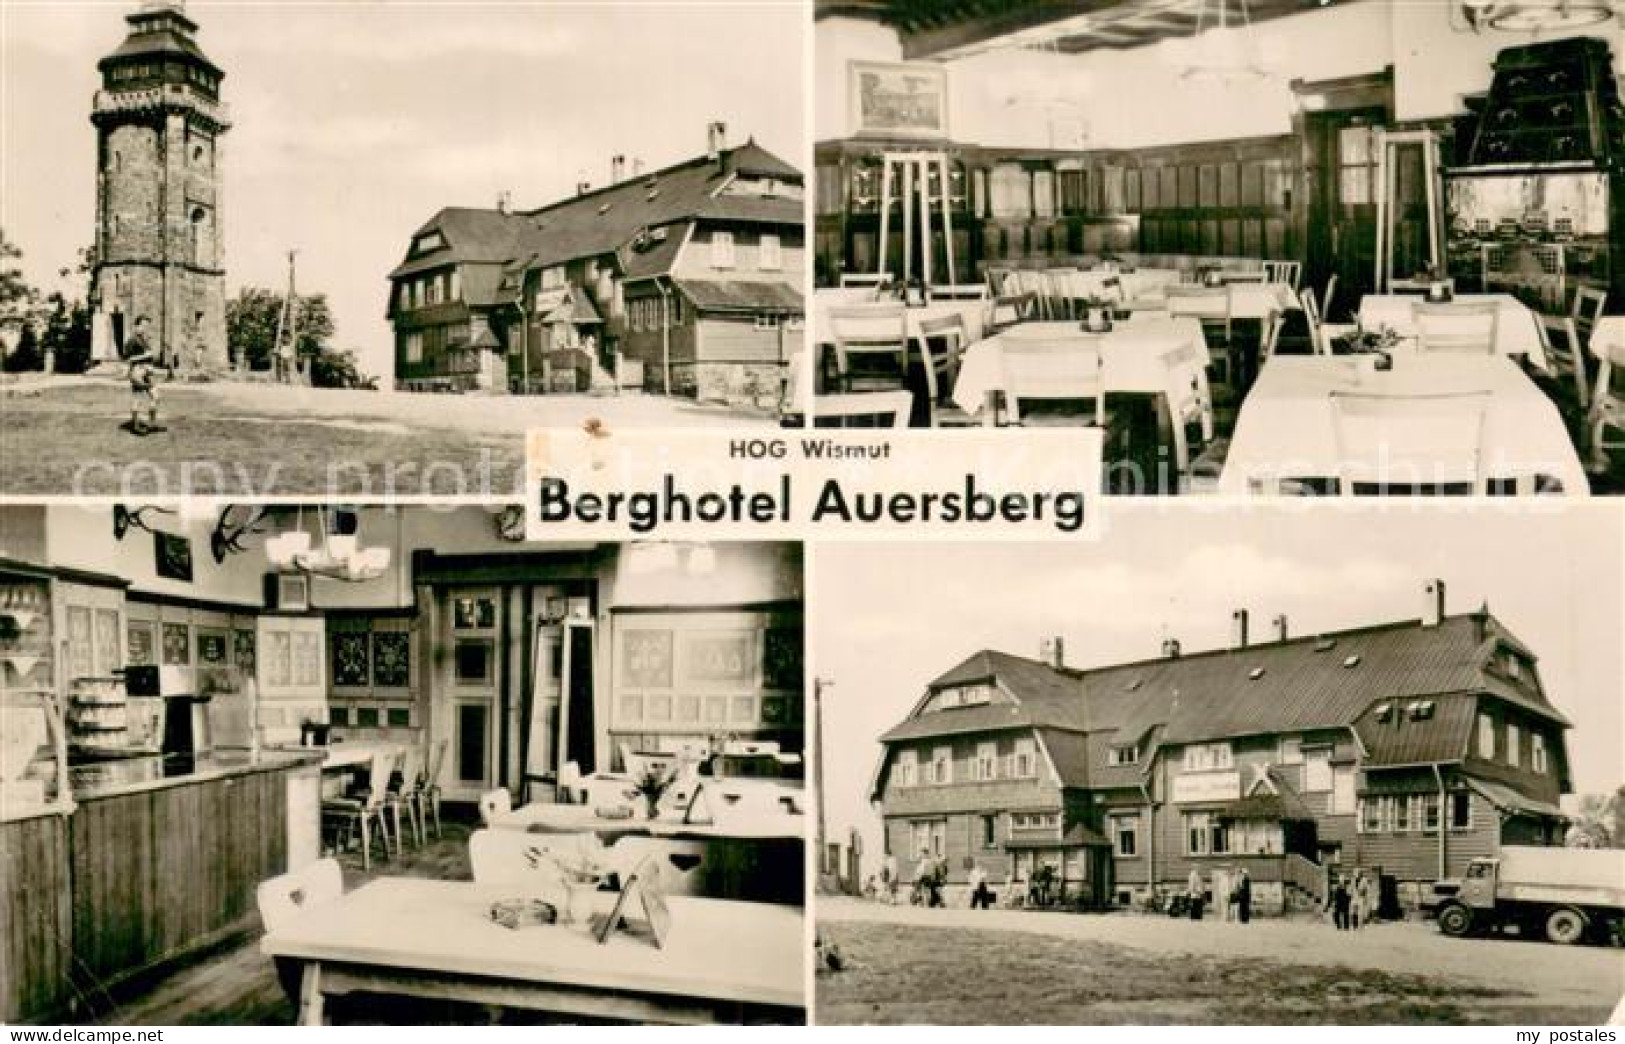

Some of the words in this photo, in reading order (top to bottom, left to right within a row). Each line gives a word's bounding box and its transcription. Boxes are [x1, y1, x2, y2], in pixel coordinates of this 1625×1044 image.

[730, 440, 788, 459] HOG
[800, 440, 891, 459] Wismut
[540, 473, 790, 533] Berghotel
[811, 473, 1086, 533] Auersberg
